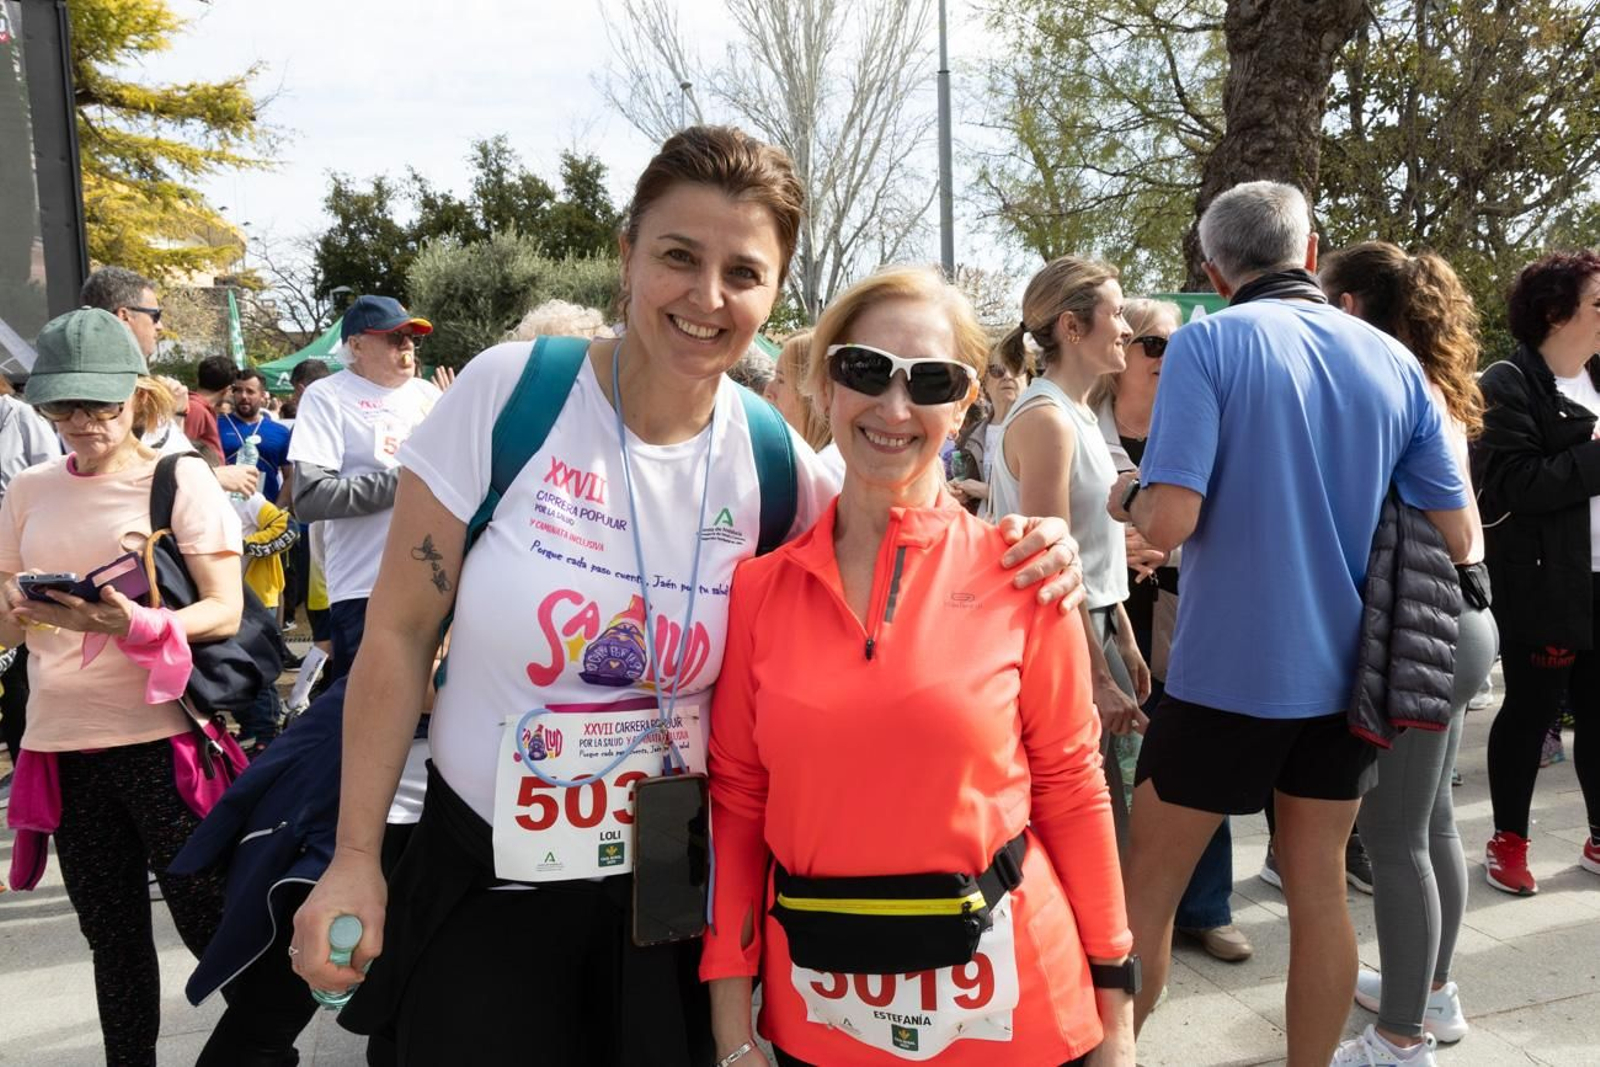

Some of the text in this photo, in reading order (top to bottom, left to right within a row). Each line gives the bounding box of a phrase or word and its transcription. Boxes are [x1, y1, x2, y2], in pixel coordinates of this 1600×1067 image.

[543, 456, 607, 504] XXVII
[534, 503, 546, 514] POR
[547, 508, 556, 517] LA
[536, 490, 627, 531] CARRERA POPULAR
[535, 521, 568, 539] CAMINATA
[570, 534, 604, 551] INCLUSIVA
[530, 540, 563, 559] Porque
[566, 557, 587, 569] cada
[591, 564, 611, 575] paso
[614, 571, 649, 586] cuent,
[652, 575, 677, 589] Jaén
[699, 585, 709, 594] tu
[526, 589, 710, 693] SALUD
[583, 723, 613, 736] XXVII
[614, 717, 650, 733] CARRERA
[579, 738, 593, 748] POR
[594, 738, 603, 748] LA
[603, 737, 623, 748] SALUD
[600, 831, 621, 841] LOLI
[873, 1010, 932, 1026] ESTEFANÍA
